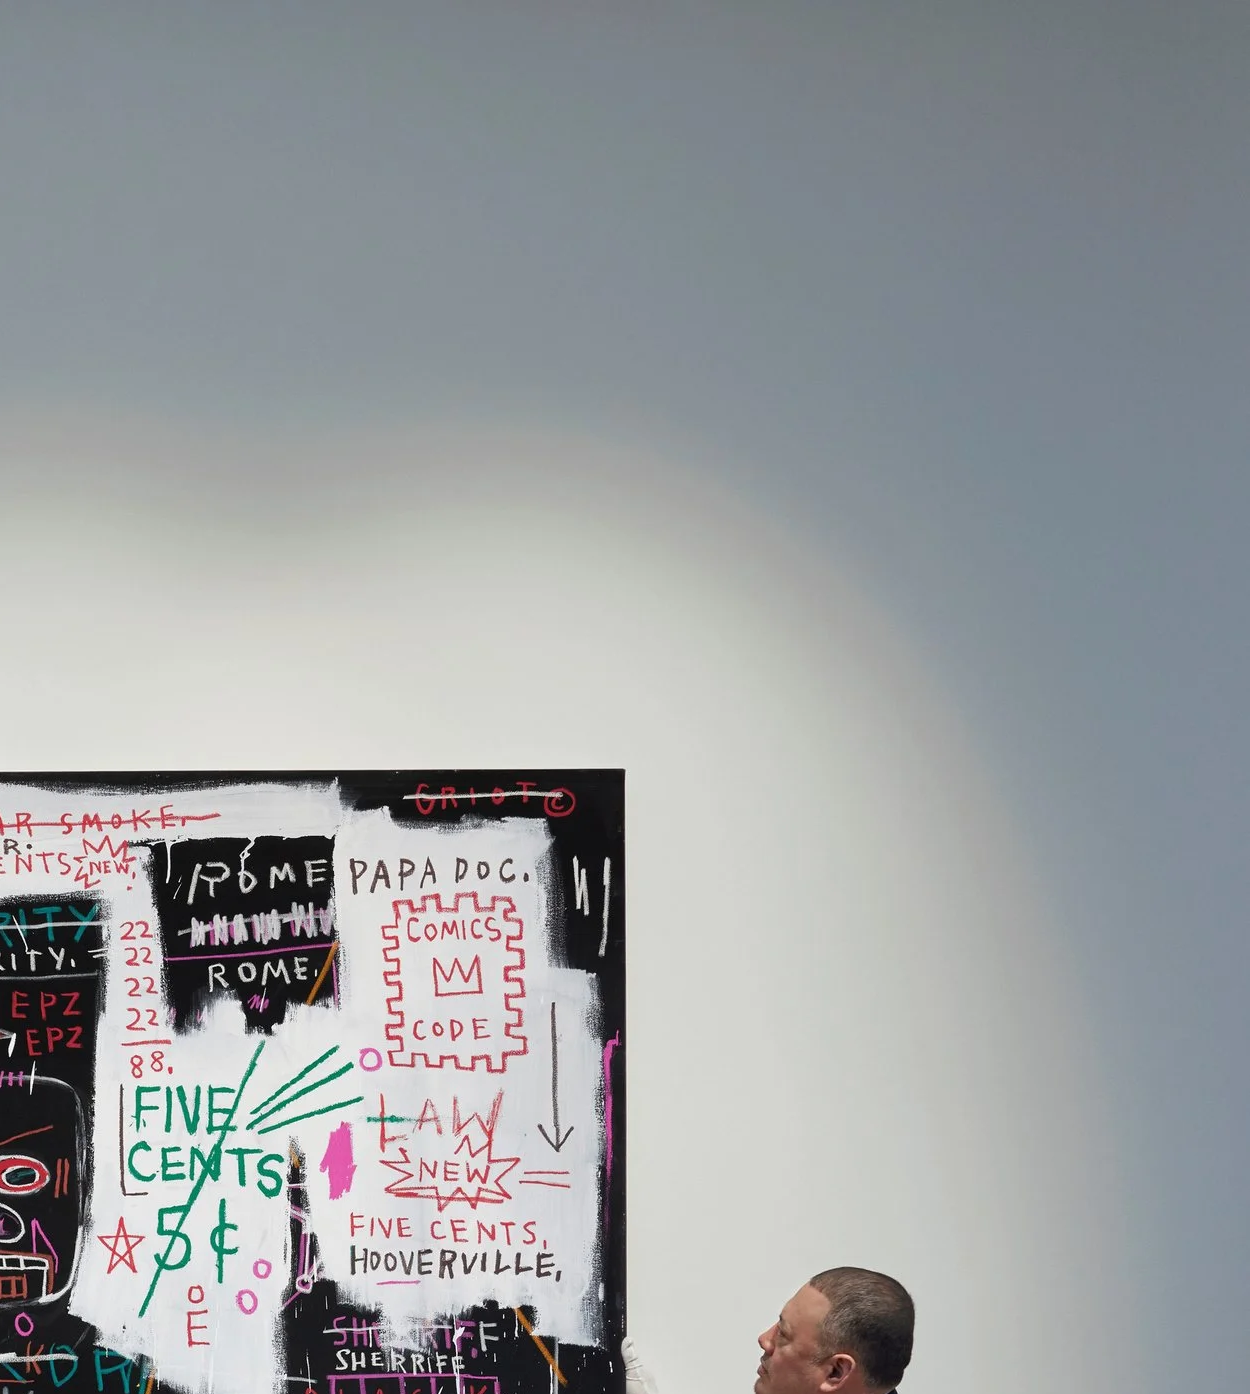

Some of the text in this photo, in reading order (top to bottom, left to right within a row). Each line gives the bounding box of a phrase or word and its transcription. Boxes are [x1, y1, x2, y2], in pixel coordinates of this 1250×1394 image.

[350, 855, 531, 896] PAPA DOC.
[119, 920, 154, 942] 22
[405, 915, 503, 943] COMICS
[123, 946, 154, 967] 22
[126, 976, 158, 998] 22
[10, 990, 84, 1021] EPZ
[125, 1007, 160, 1032] 22
[25, 1026, 85, 1057] EPZ
[412, 1017, 493, 1042] CODE
[134, 1084, 238, 1135] FIVE
[127, 1139, 286, 1200] CENTS
[418, 1156, 491, 1185] NEW
[349, 1211, 413, 1240] FIVE
